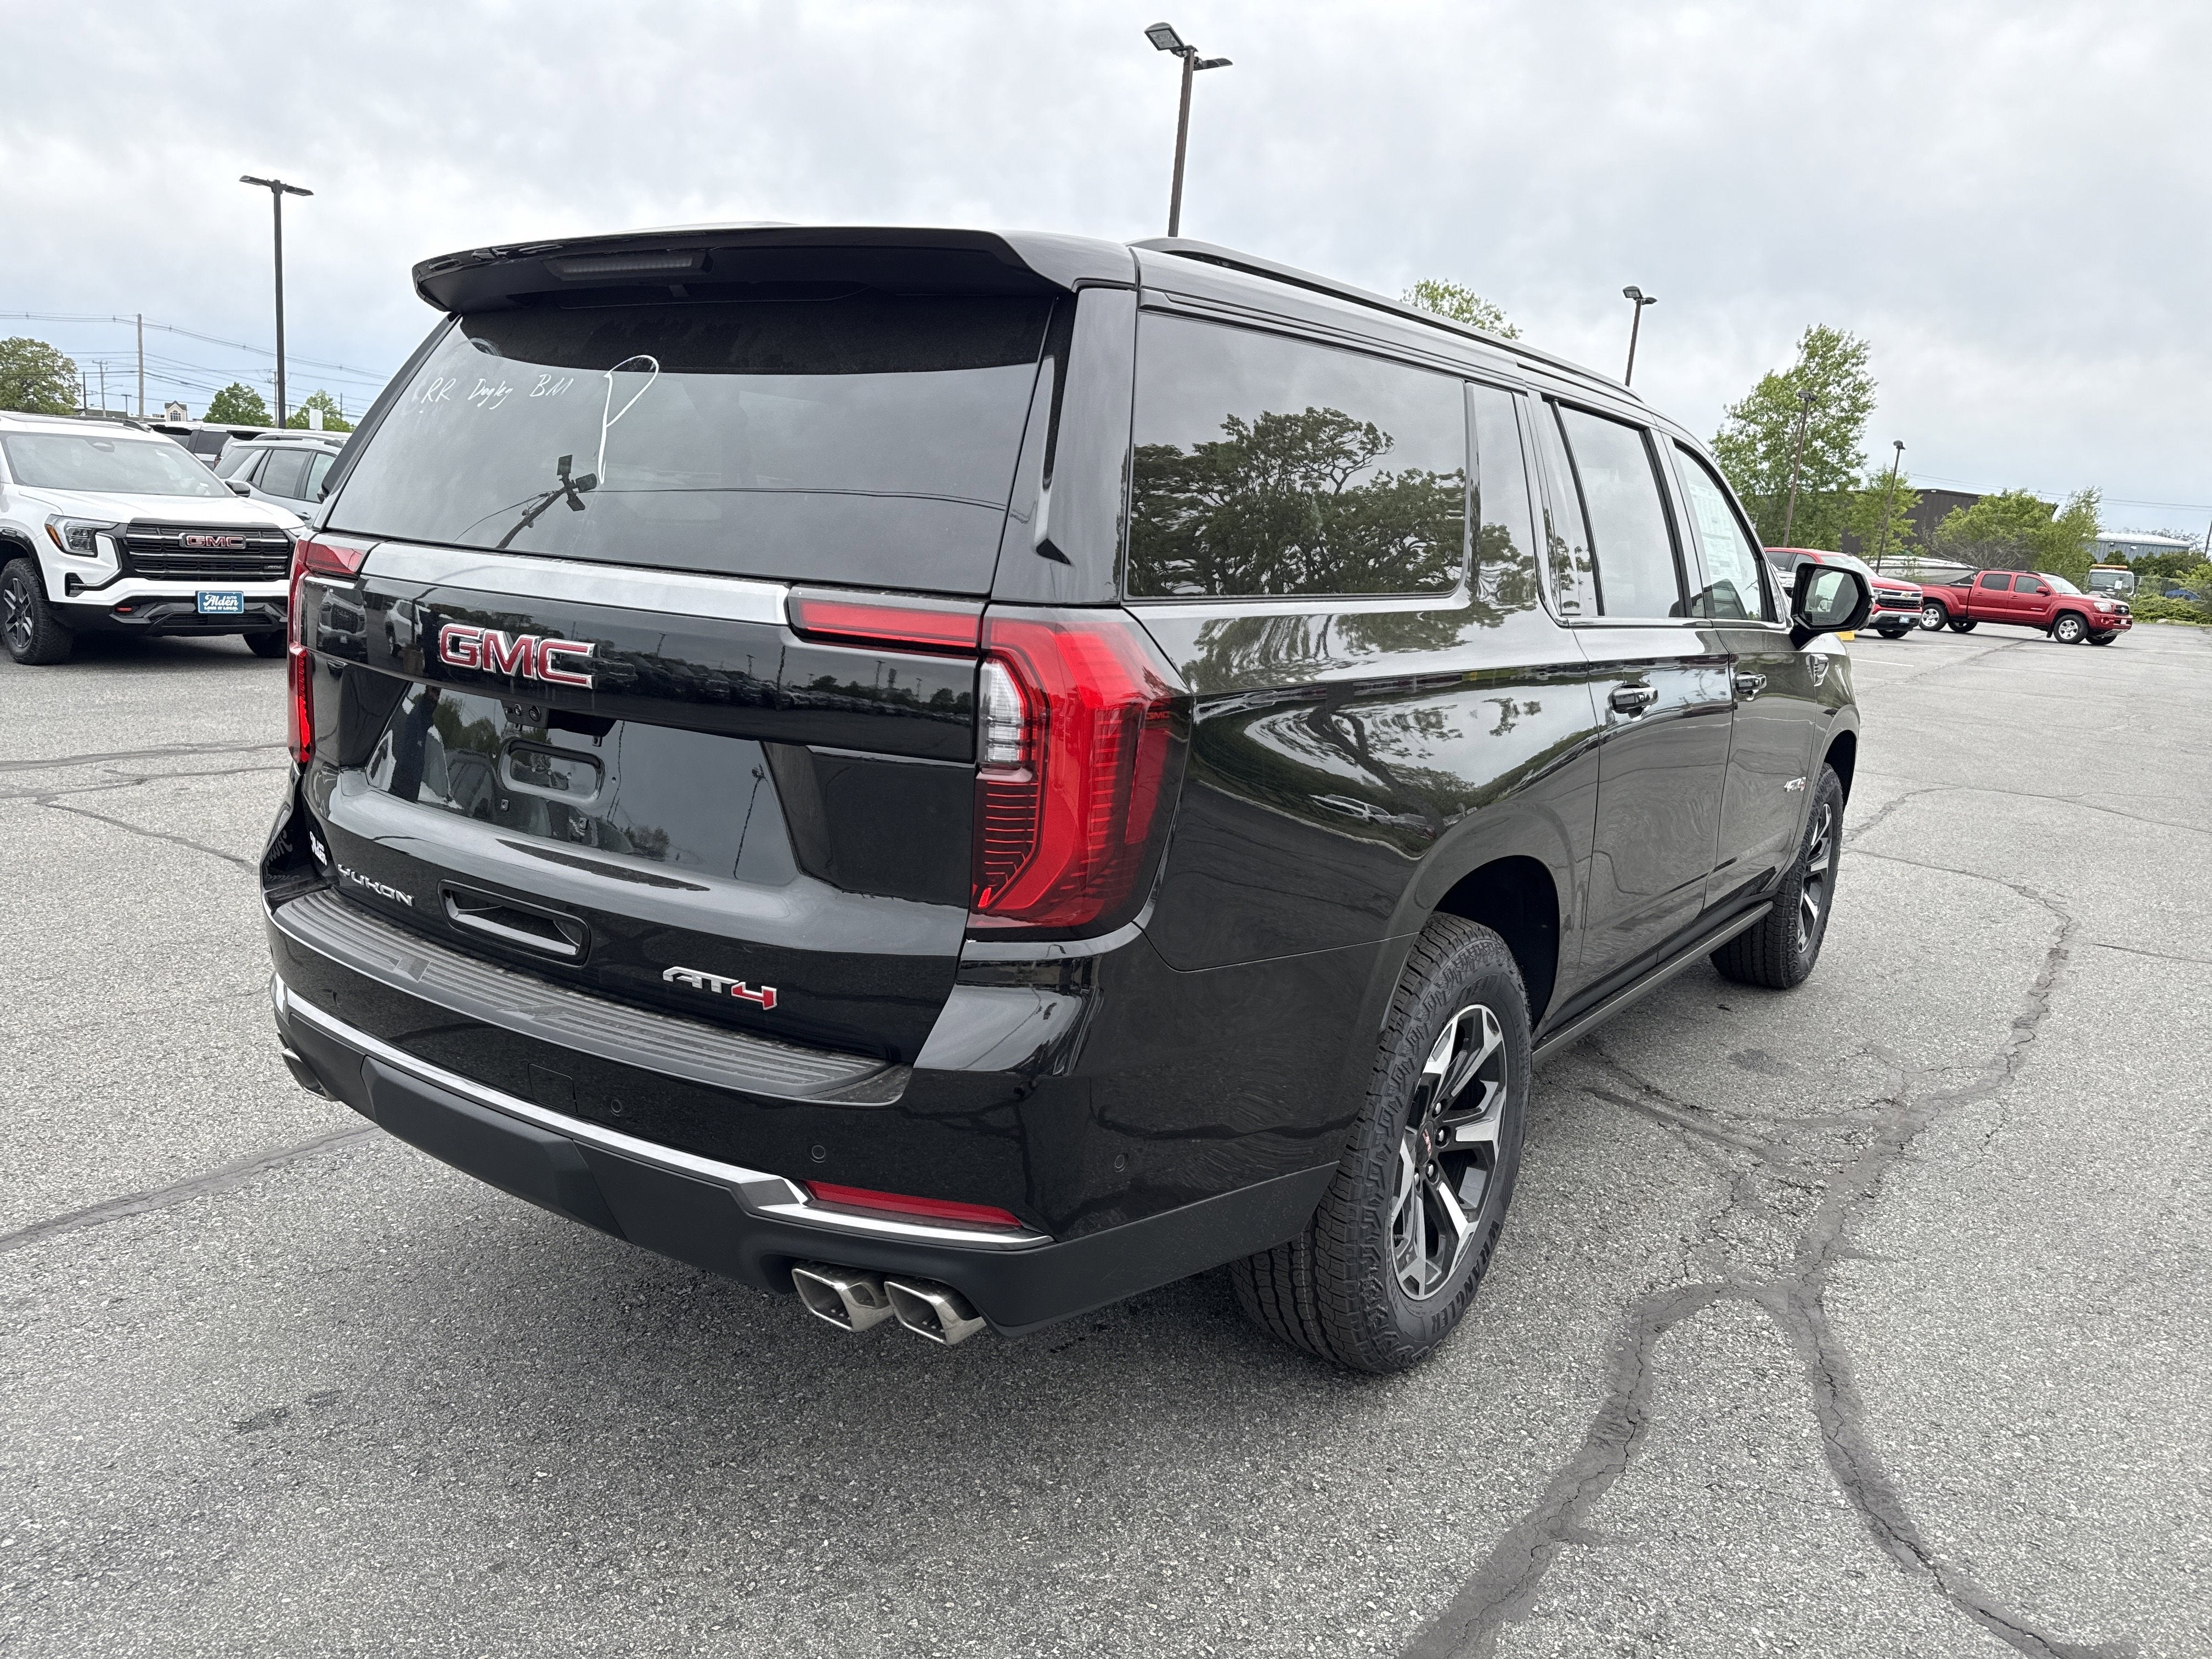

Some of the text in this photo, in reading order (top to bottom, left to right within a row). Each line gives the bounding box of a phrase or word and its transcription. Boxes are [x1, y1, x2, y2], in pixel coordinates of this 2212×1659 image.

[421, 377, 456, 403] RR
[186, 535, 244, 547] GMC
[203, 594, 239, 606] Alden
[439, 623, 598, 690] GMC
[337, 864, 416, 907] YUKON
[662, 966, 777, 1011] AT4
[1431, 1220, 1500, 1335] WRANGLER
